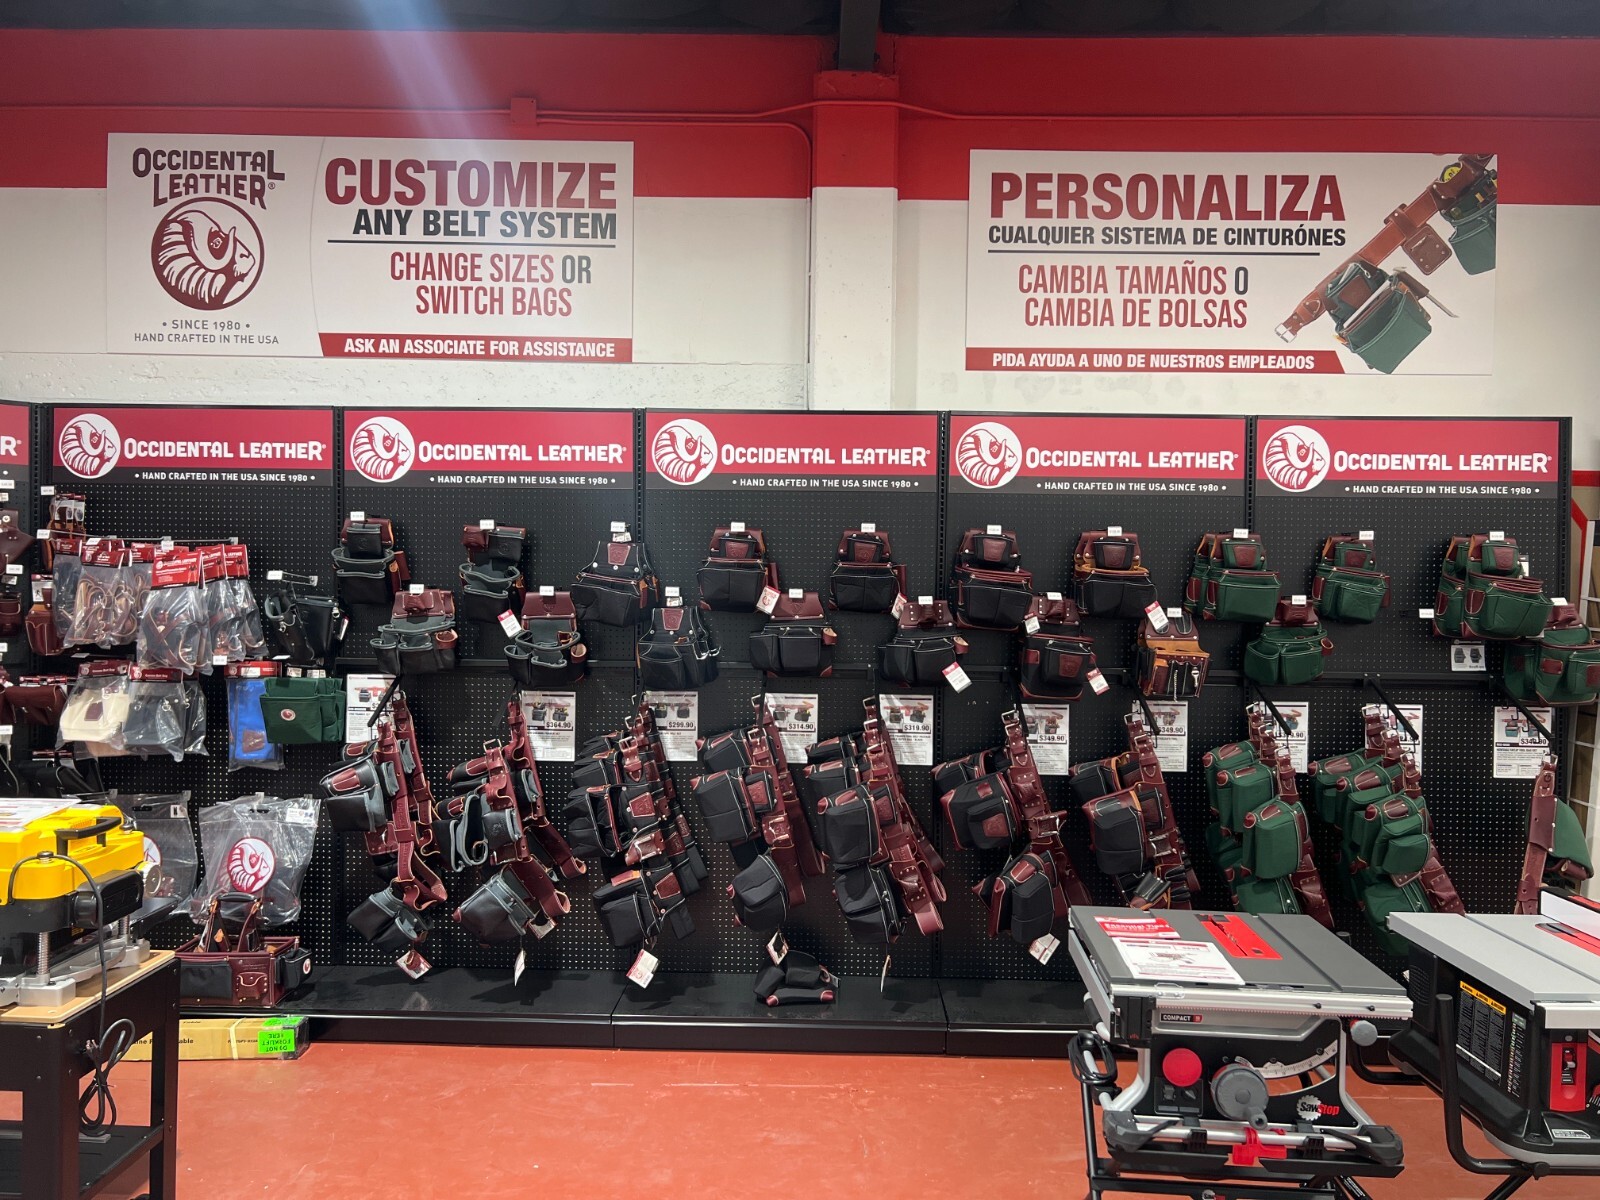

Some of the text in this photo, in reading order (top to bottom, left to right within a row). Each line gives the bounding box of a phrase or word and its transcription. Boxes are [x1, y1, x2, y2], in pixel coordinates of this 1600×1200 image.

[132, 147, 286, 181] OCCIDENTAL
[324, 157, 617, 209] CUSTOMIZE
[990, 171, 1346, 222] PERSONALIZA
[352, 208, 617, 240] ANY BELT SYSTEM
[988, 223, 1346, 247] CUALQUIER SISTEMA DE CINTURÓNES
[390, 251, 592, 284] CHANGE SIZES OR
[1018, 259, 1249, 296] CAMBIA TAMAÑOS O
[415, 284, 572, 317] SWITCH BAGS
[1024, 297, 1248, 329] CAMBIA DE BOLSAS
[171, 319, 241, 332] SINCE 1980
[135, 332, 279, 345] HAND CRAFTED IN THE USA
[344, 338, 615, 358] ASK AN ASSOCIATE FOR ASSISTANCE
[992, 352, 1315, 370] PIDA AYUDA A UNO DE NUESTROS EMPLEADOS
[124, 437, 234, 459] OCCIDENTAL
[418, 441, 532, 463] OCCIDENTAL
[721, 443, 835, 466] OCCIDENTAL
[1026, 447, 1142, 469] OCCIDENTAL
[1333, 451, 1453, 472] OCCIDENTAL
[143, 471, 308, 483] HAND CRAFTED IN THE USA SINCE 1980
[438, 475, 608, 486] HAND CRAFTED IN THE USA SINCE 1980
[740, 478, 911, 489] HAND CRAFTED IN THE USA SINCE 1980
[1045, 481, 1219, 493] HAND CRAFTED IN THE USA SINCE 1980
[1353, 485, 1532, 496] HAND CRAFTED IN THE USA SINCE 1980
[1163, 1014, 1191, 1022] COMPACT
[1300, 1102, 1340, 1116] SawStop
